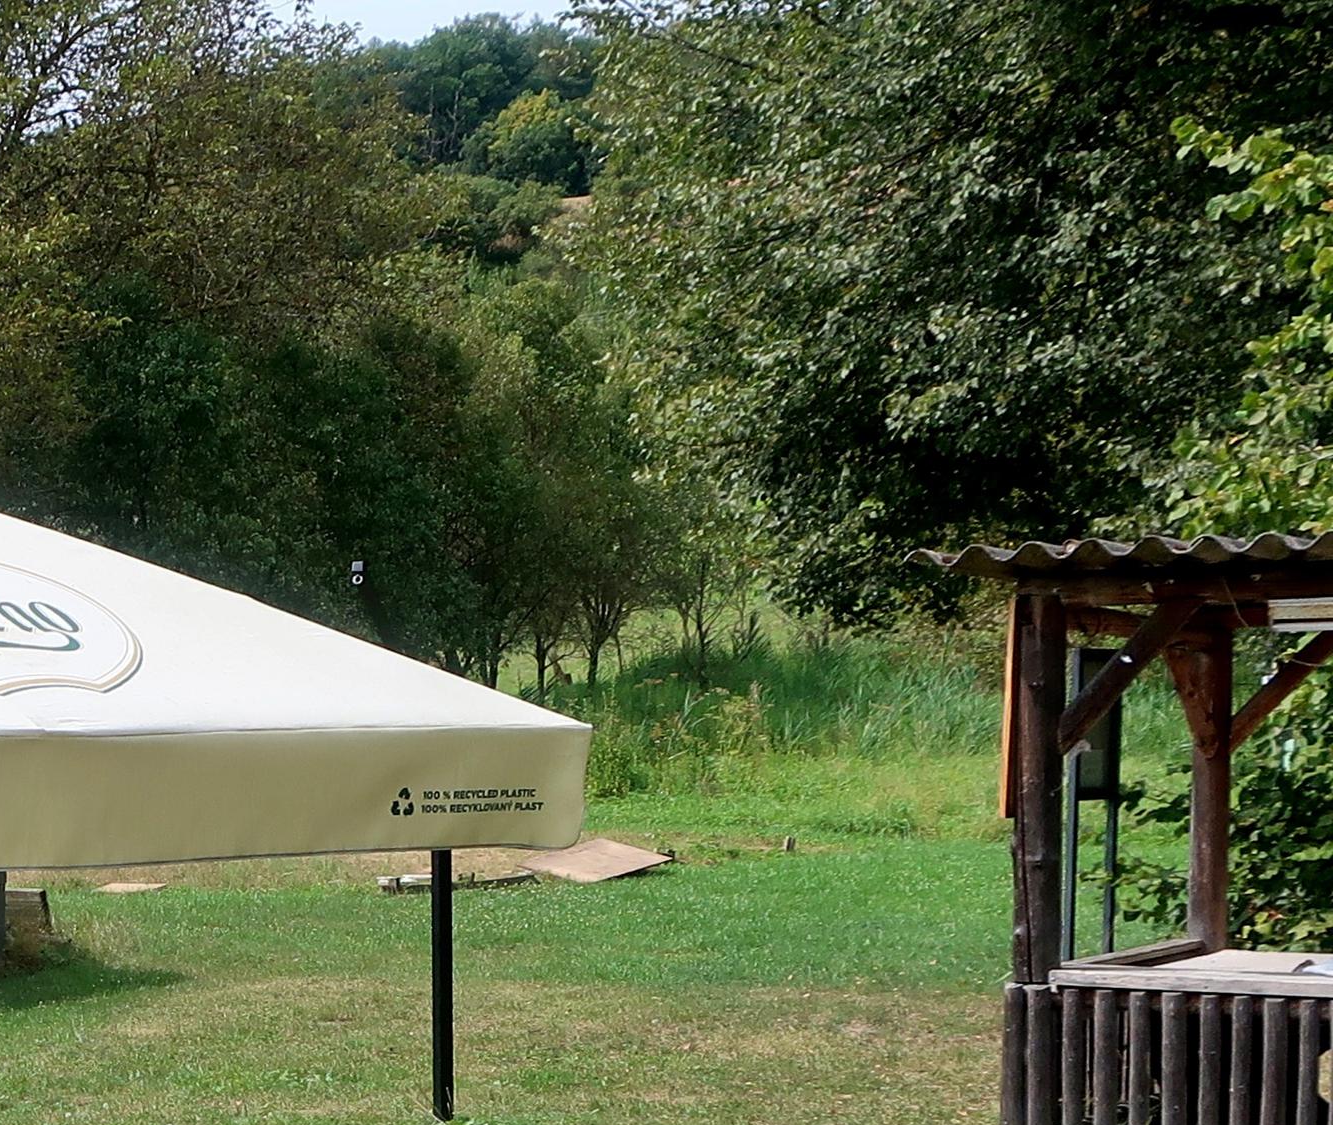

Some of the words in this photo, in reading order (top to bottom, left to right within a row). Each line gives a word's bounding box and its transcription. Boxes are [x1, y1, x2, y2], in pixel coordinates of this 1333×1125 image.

[423, 790, 440, 800] 100
[453, 789, 498, 799] RECYCLED
[500, 788, 536, 798] PLASTIC
[421, 804, 447, 814] 100%
[514, 802, 544, 811] PLAST
